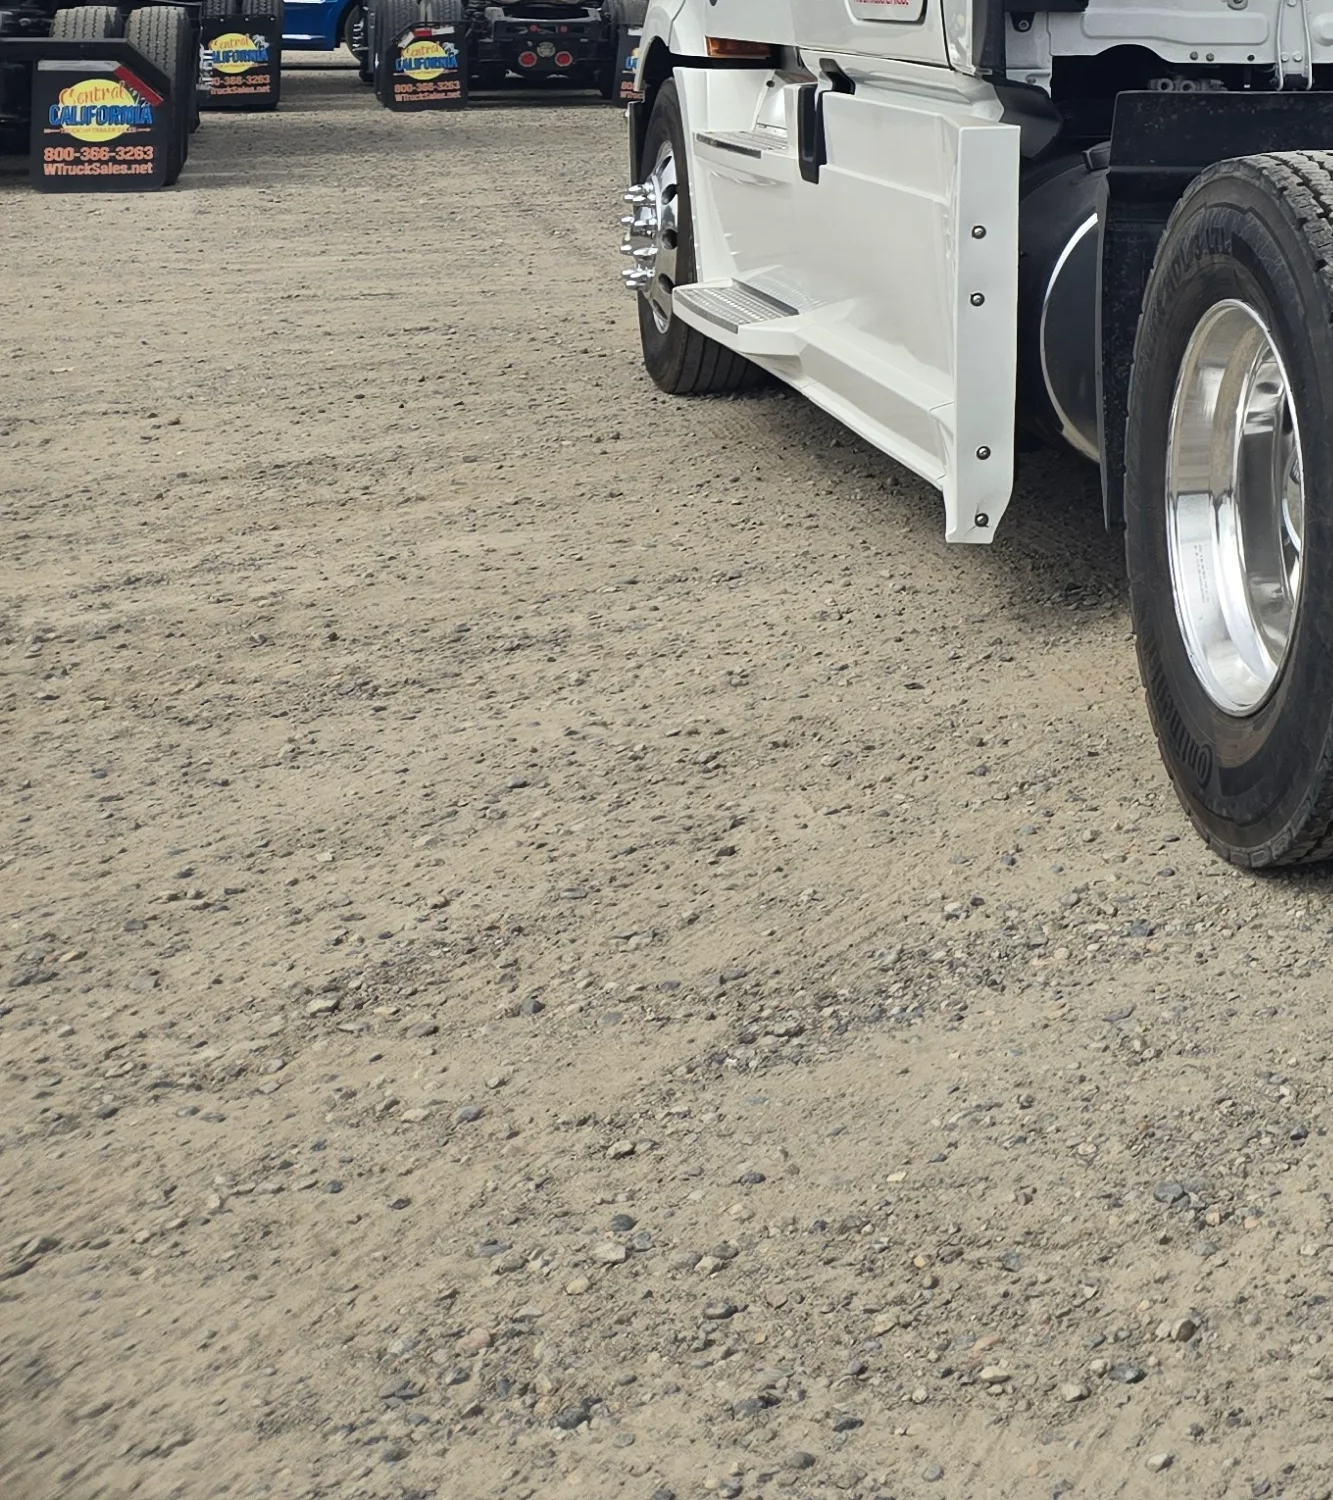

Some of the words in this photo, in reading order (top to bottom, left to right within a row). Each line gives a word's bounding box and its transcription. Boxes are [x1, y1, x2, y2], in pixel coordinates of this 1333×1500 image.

[395, 55, 458, 71] CALIFORNIA
[59, 80, 125, 105] Central
[49, 104, 152, 126] CALIFORNIA
[44, 147, 153, 161] 800-366-3263
[44, 163, 153, 175] WTruckSales.net
